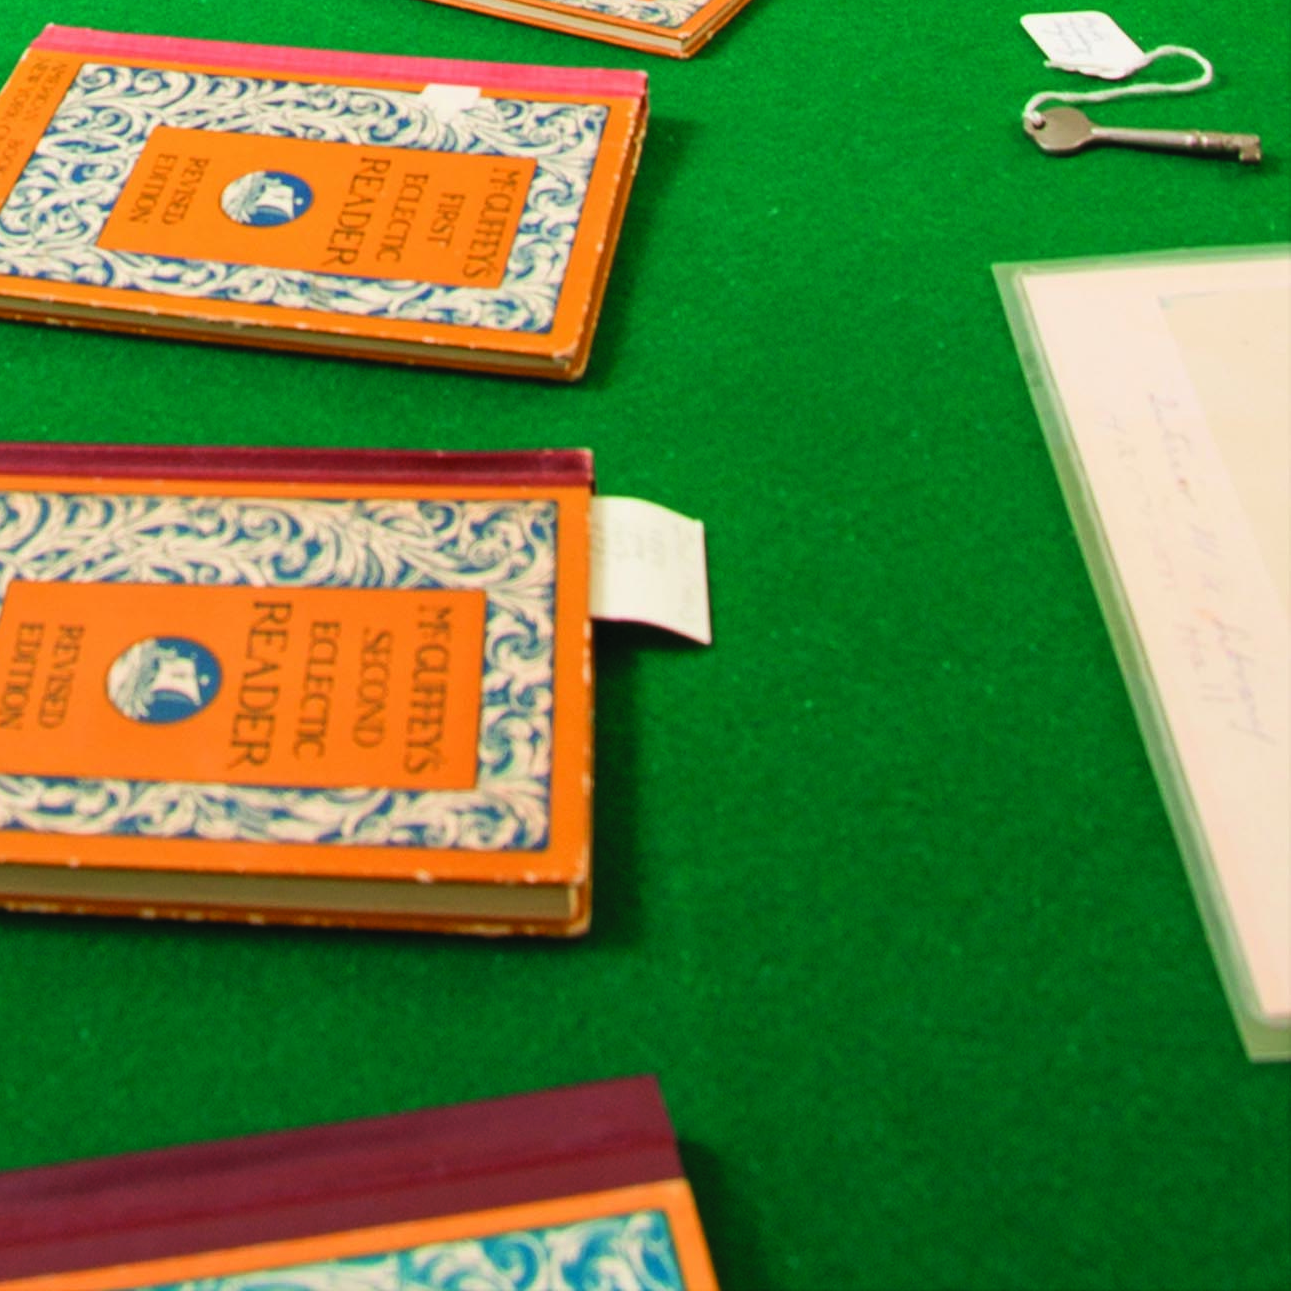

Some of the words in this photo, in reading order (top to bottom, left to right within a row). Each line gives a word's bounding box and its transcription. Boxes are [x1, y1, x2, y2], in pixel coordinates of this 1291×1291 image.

[128, 153, 179, 225] EDITION
[161, 157, 210, 226] REVISED
[321, 157, 391, 267] READER
[376, 173, 430, 263] ECLECTIC
[427, 192, 466, 249] FIRST
[38, 624, 85, 729] REVISED
[226, 600, 293, 770] READER
[292, 620, 341, 761] ECLECTIC
[352, 627, 394, 749] SECOND
